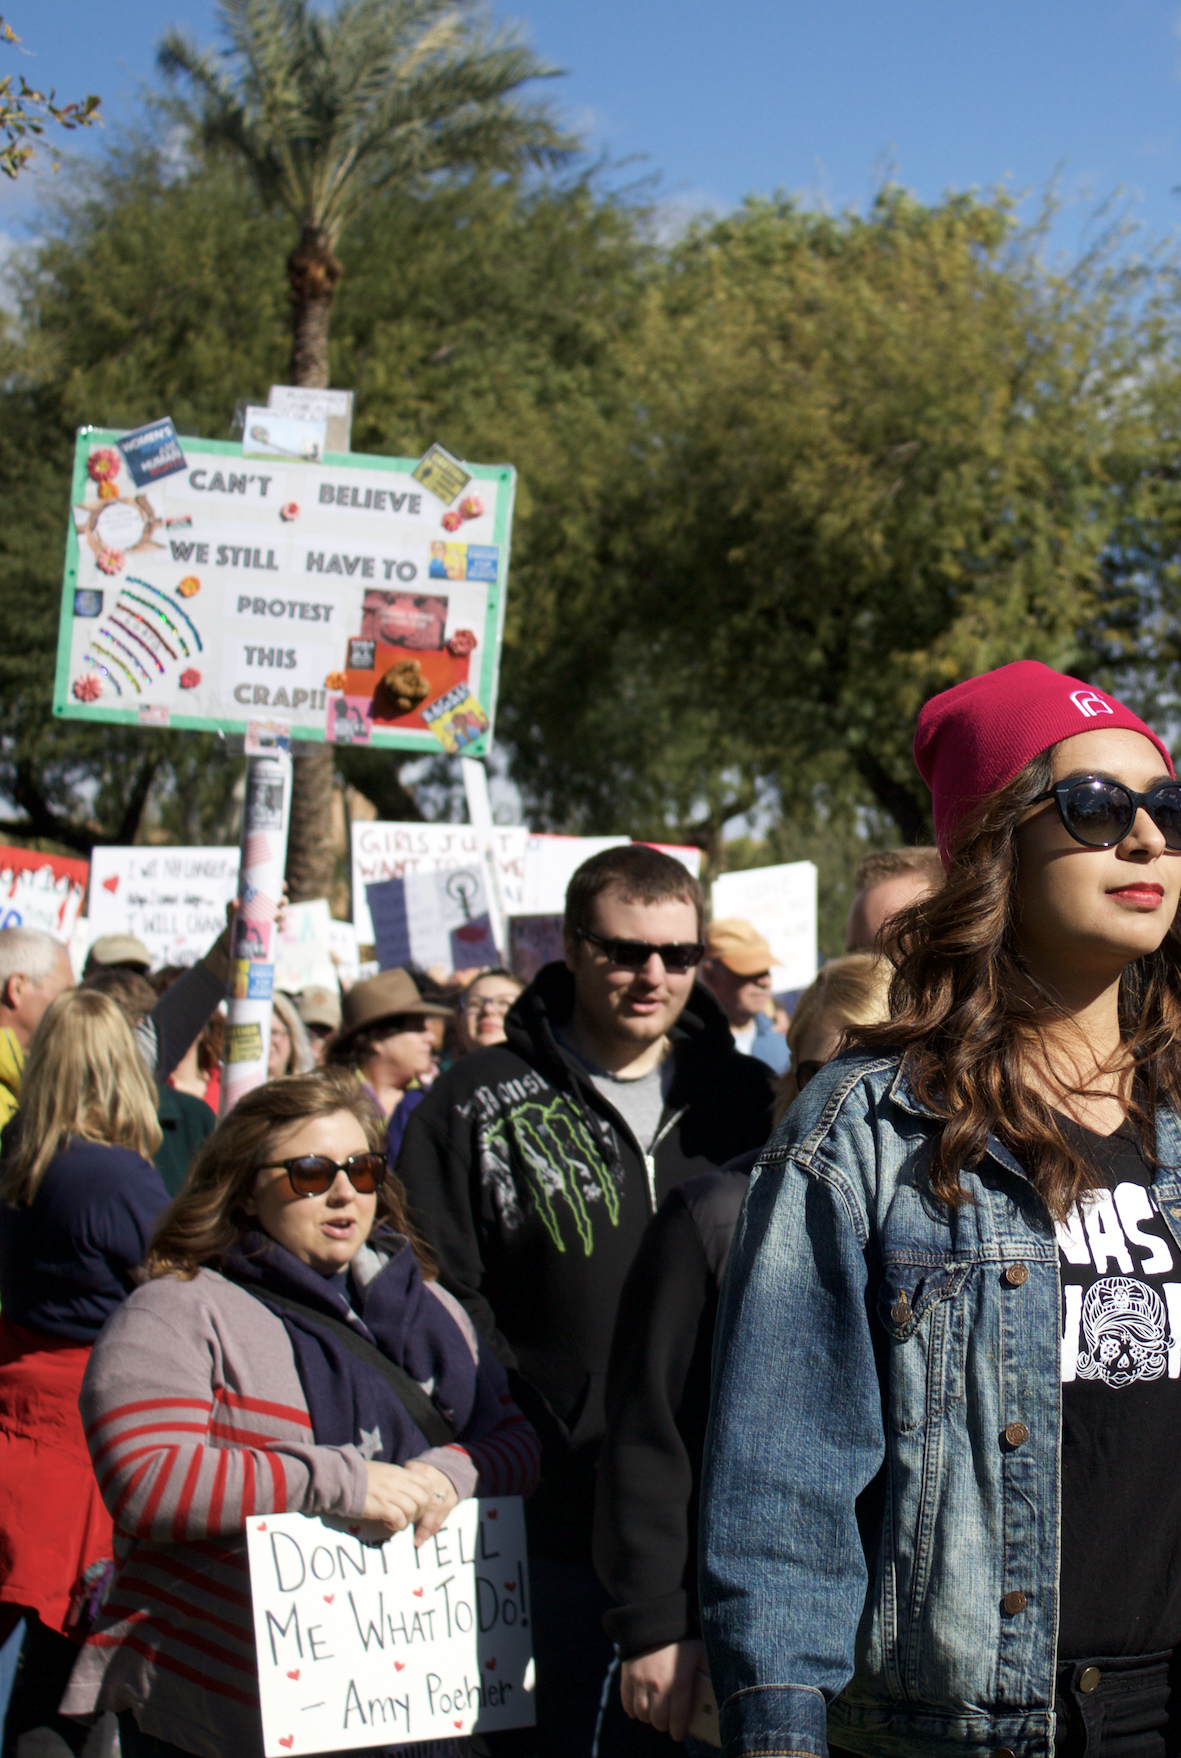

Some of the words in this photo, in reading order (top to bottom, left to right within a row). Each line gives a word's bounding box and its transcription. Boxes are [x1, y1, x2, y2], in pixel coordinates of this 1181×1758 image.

[188, 468, 272, 496] CAN'T
[318, 483, 422, 514] BELIEVE
[169, 540, 209, 564] WE
[215, 544, 279, 571] STILL
[305, 551, 375, 578] HAVE
[382, 557, 418, 582] TO
[237, 594, 334, 622] PROTEST
[243, 645, 297, 670] THIS
[233, 682, 327, 711] CRAP!!
[359, 829, 430, 855] GIRLS
[439, 832, 514, 853] JUT
[186, 912, 226, 935] CHAN
[1054, 1181, 1175, 1275] NAS
[343, 1678, 411, 1734] Amy
[425, 1673, 513, 1717] Poehler
